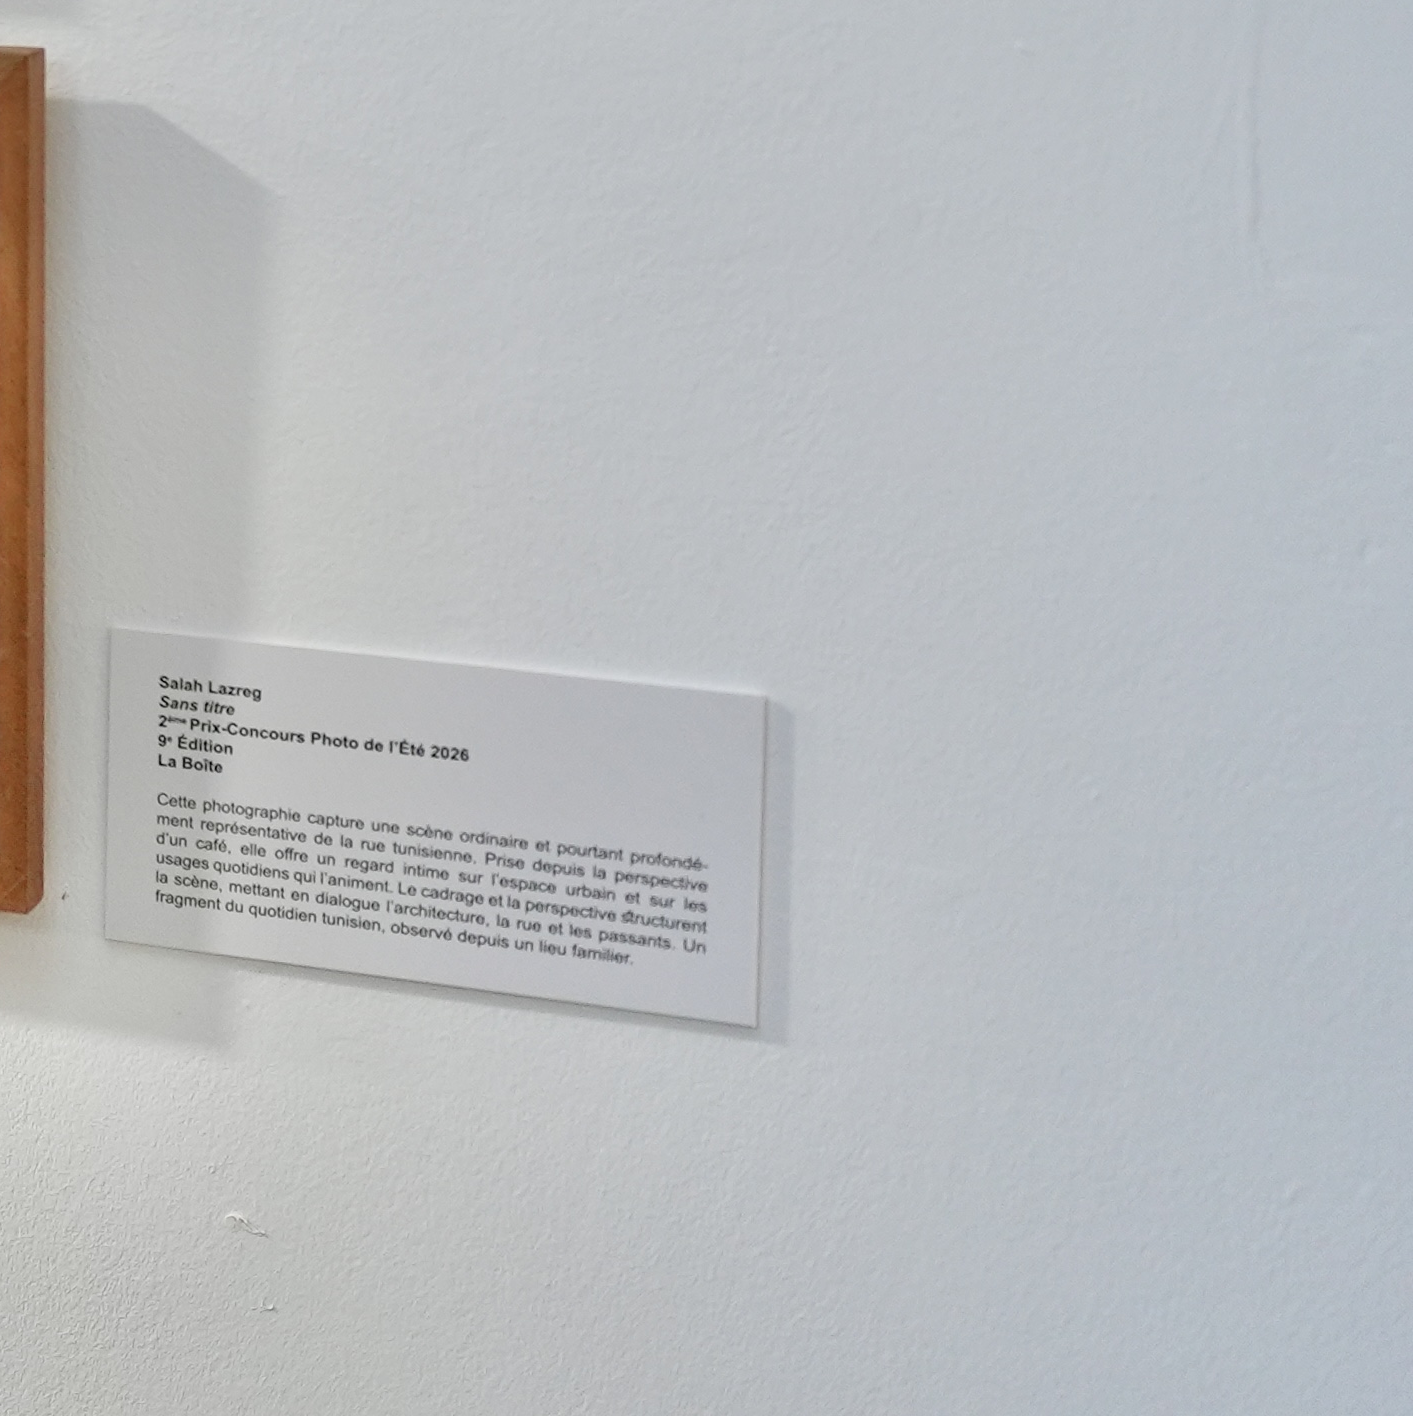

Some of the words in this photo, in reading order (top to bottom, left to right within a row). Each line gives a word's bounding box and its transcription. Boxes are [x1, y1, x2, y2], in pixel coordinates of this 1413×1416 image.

[158, 675, 203, 692] Salah
[207, 681, 262, 702] Lazreg
[158, 695, 198, 712] Sans
[203, 701, 235, 715] titre
[157, 753, 176, 769] La
[181, 756, 223, 774] Boîte
[177, 734, 233, 755] Édition
[189, 718, 305, 744] Prix-Concours
[309, 731, 359, 750] Photo
[363, 737, 383, 753] de
[388, 739, 425, 757] l'Été
[430, 745, 469, 762] 2026
[156, 792, 196, 810] Cette
[202, 800, 300, 822] photographie
[306, 813, 364, 830] capture
[370, 822, 400, 835] une
[406, 825, 453, 841] scène
[458, 832, 528, 850] ordinaire
[534, 840, 549, 853] et
[556, 843, 623, 861] pourtant
[156, 814, 193, 829] ment
[200, 820, 306, 842] représentative
[313, 832, 333, 846] de
[339, 834, 353, 849] la
[360, 840, 385, 853] rue
[484, 851, 524, 870] Prise
[532, 859, 585, 877] depuis
[592, 865, 606, 880] la
[614, 871, 708, 892] perspective
[155, 832, 187, 847] d'un
[240, 843, 266, 858] elle
[274, 847, 308, 863] offre
[316, 855, 335, 866] un
[344, 858, 394, 874] regard
[403, 863, 449, 881] intime
[458, 872, 482, 884] sur
[491, 874, 556, 894] l'espace
[565, 885, 616, 900] urbain
[624, 892, 640, 904] et
[649, 895, 674, 909] sur
[683, 898, 707, 913] les
[155, 854, 209, 871] usages
[212, 861, 289, 880] quotidiens
[293, 871, 316, 885] qui
[397, 881, 416, 897] Le
[420, 887, 484, 907] cadrage
[488, 895, 502, 907] et
[506, 895, 520, 910] la
[524, 901, 616, 922] perspective
[621, 910, 706, 934] structurent
[155, 870, 168, 884] la
[228, 883, 284, 899] mettant
[290, 890, 309, 902] en
[314, 892, 380, 912] dialogue
[496, 914, 510, 929] la
[516, 919, 541, 933] rue
[547, 922, 563, 935] et
[568, 924, 592, 939] les
[682, 938, 706, 955] Un
[155, 889, 220, 910] fragment
[224, 900, 243, 913] du
[248, 905, 316, 923] quotidien
[390, 922, 452, 941] observé
[456, 930, 509, 948] depuis
[514, 939, 533, 952] un
[538, 940, 566, 956] lieu
